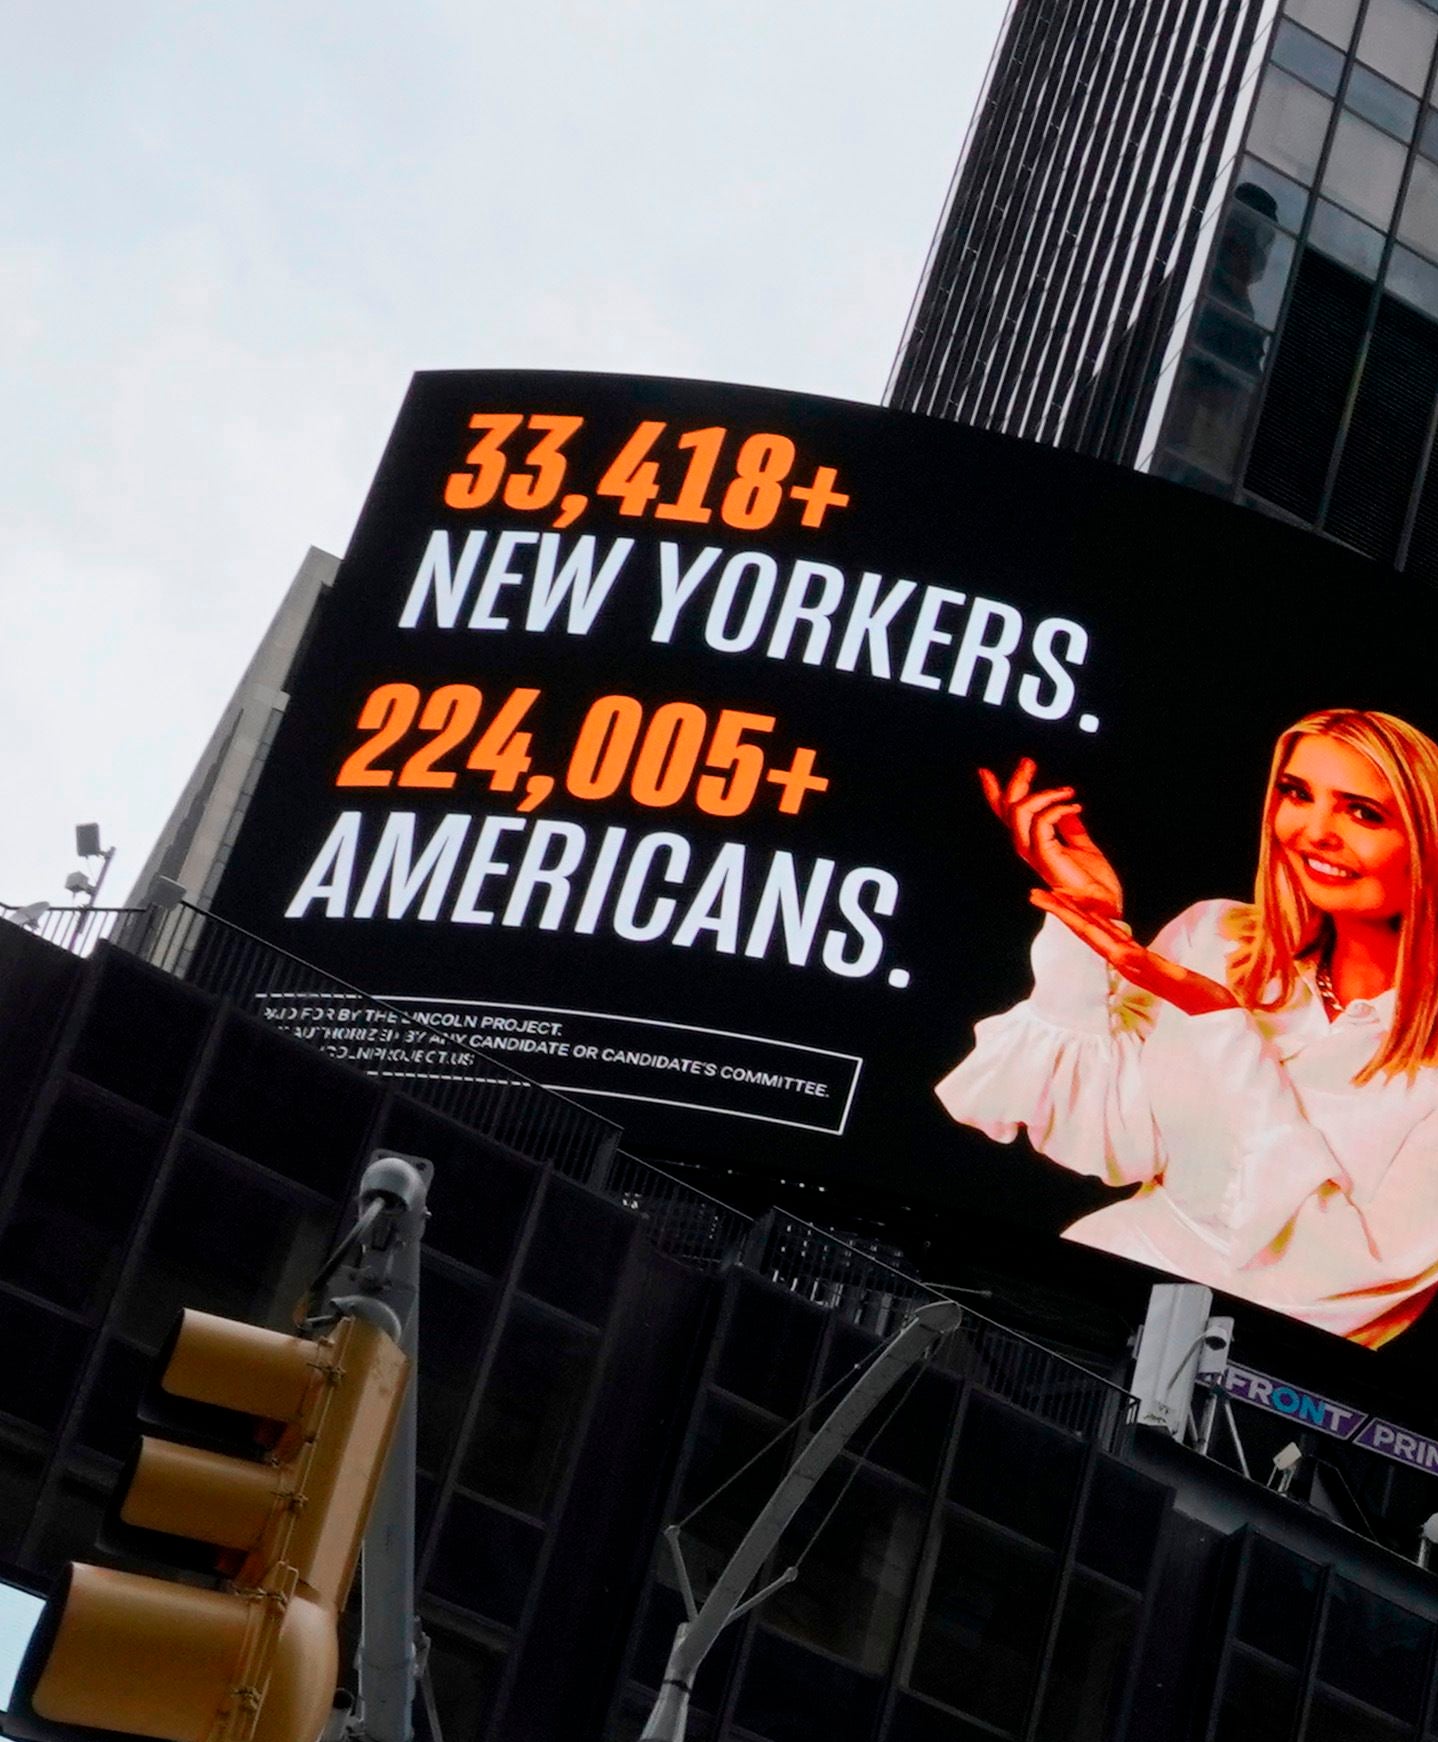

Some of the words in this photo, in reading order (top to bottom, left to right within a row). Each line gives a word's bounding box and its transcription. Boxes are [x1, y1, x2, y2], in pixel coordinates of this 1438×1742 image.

[444, 412, 850, 530] 33,418+
[398, 528, 636, 636] NEW
[649, 539, 1102, 734] YORKERS.
[335, 683, 829, 817] 224,005+
[284, 811, 912, 990] AMERICANS.
[468, 1033, 570, 1058] CANDIDATE
[572, 1043, 599, 1060] OR
[600, 1047, 718, 1078] CANDIDATE'S
[719, 1065, 830, 1099] COMMITTEE.
[480, 1015, 562, 1037] PROJECT.
